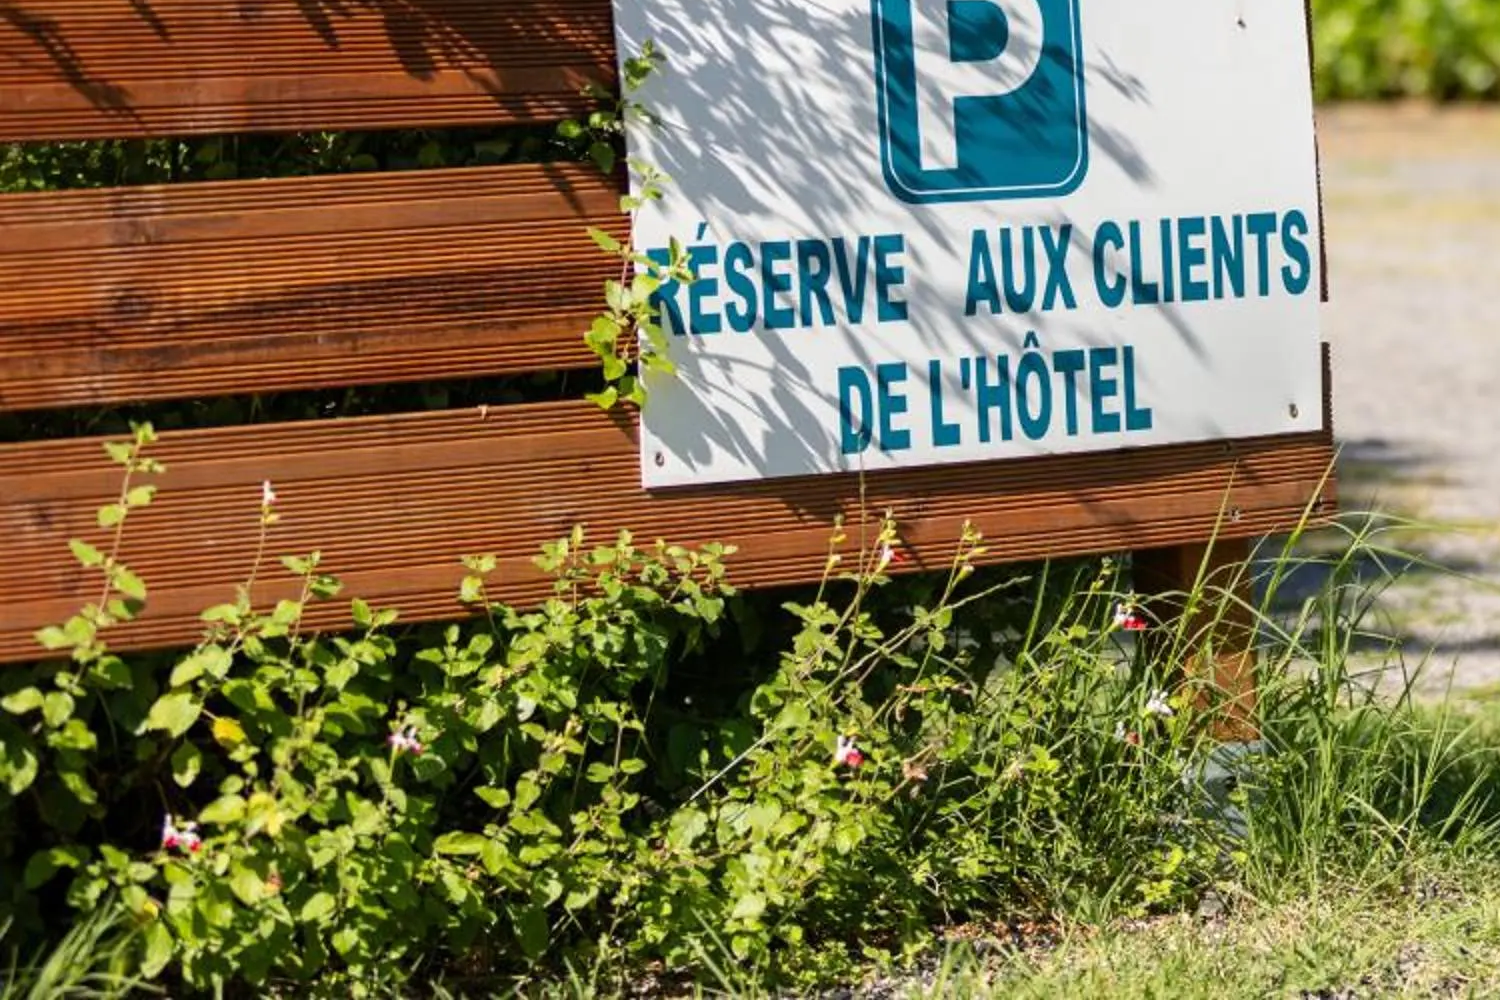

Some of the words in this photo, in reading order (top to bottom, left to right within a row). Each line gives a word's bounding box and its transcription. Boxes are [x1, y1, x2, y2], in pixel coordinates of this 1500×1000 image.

[965, 223, 1078, 316] AUX
[1092, 209, 1311, 309] CLIENTS
[838, 363, 912, 455] DE
[929, 331, 1153, 447] L'HÔTEL
